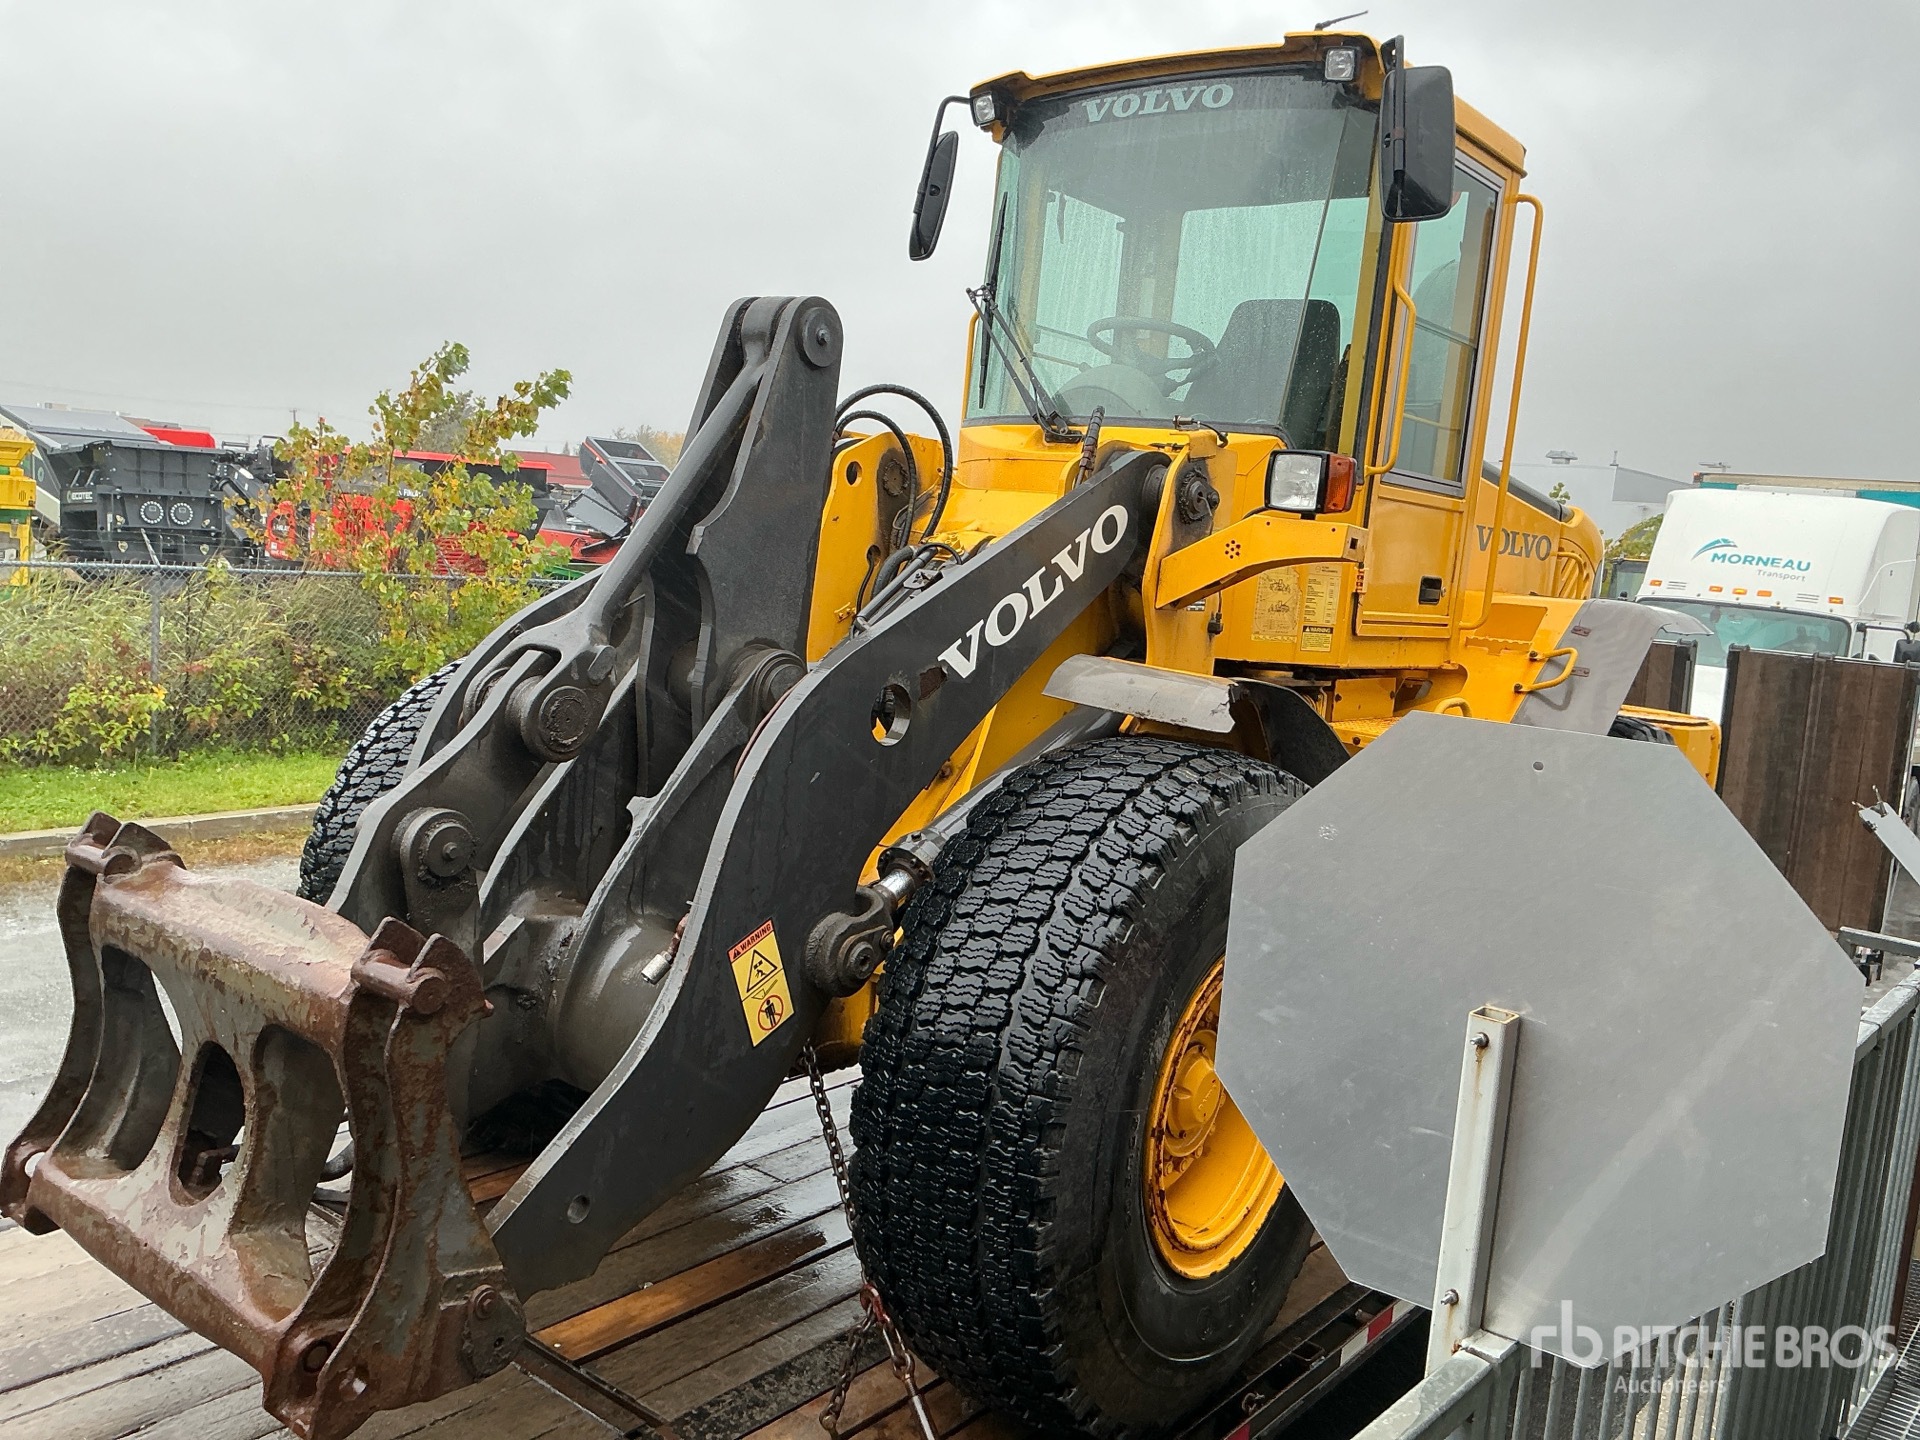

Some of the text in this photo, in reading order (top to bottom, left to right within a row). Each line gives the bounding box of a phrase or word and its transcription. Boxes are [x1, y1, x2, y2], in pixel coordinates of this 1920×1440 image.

[1082, 83, 1234, 123] VOLVO
[1710, 552, 1811, 572] MORNEAU
[1757, 569, 1806, 582] Transport
[936, 504, 1129, 679] VOLVO
[739, 922, 772, 952] WARNING
